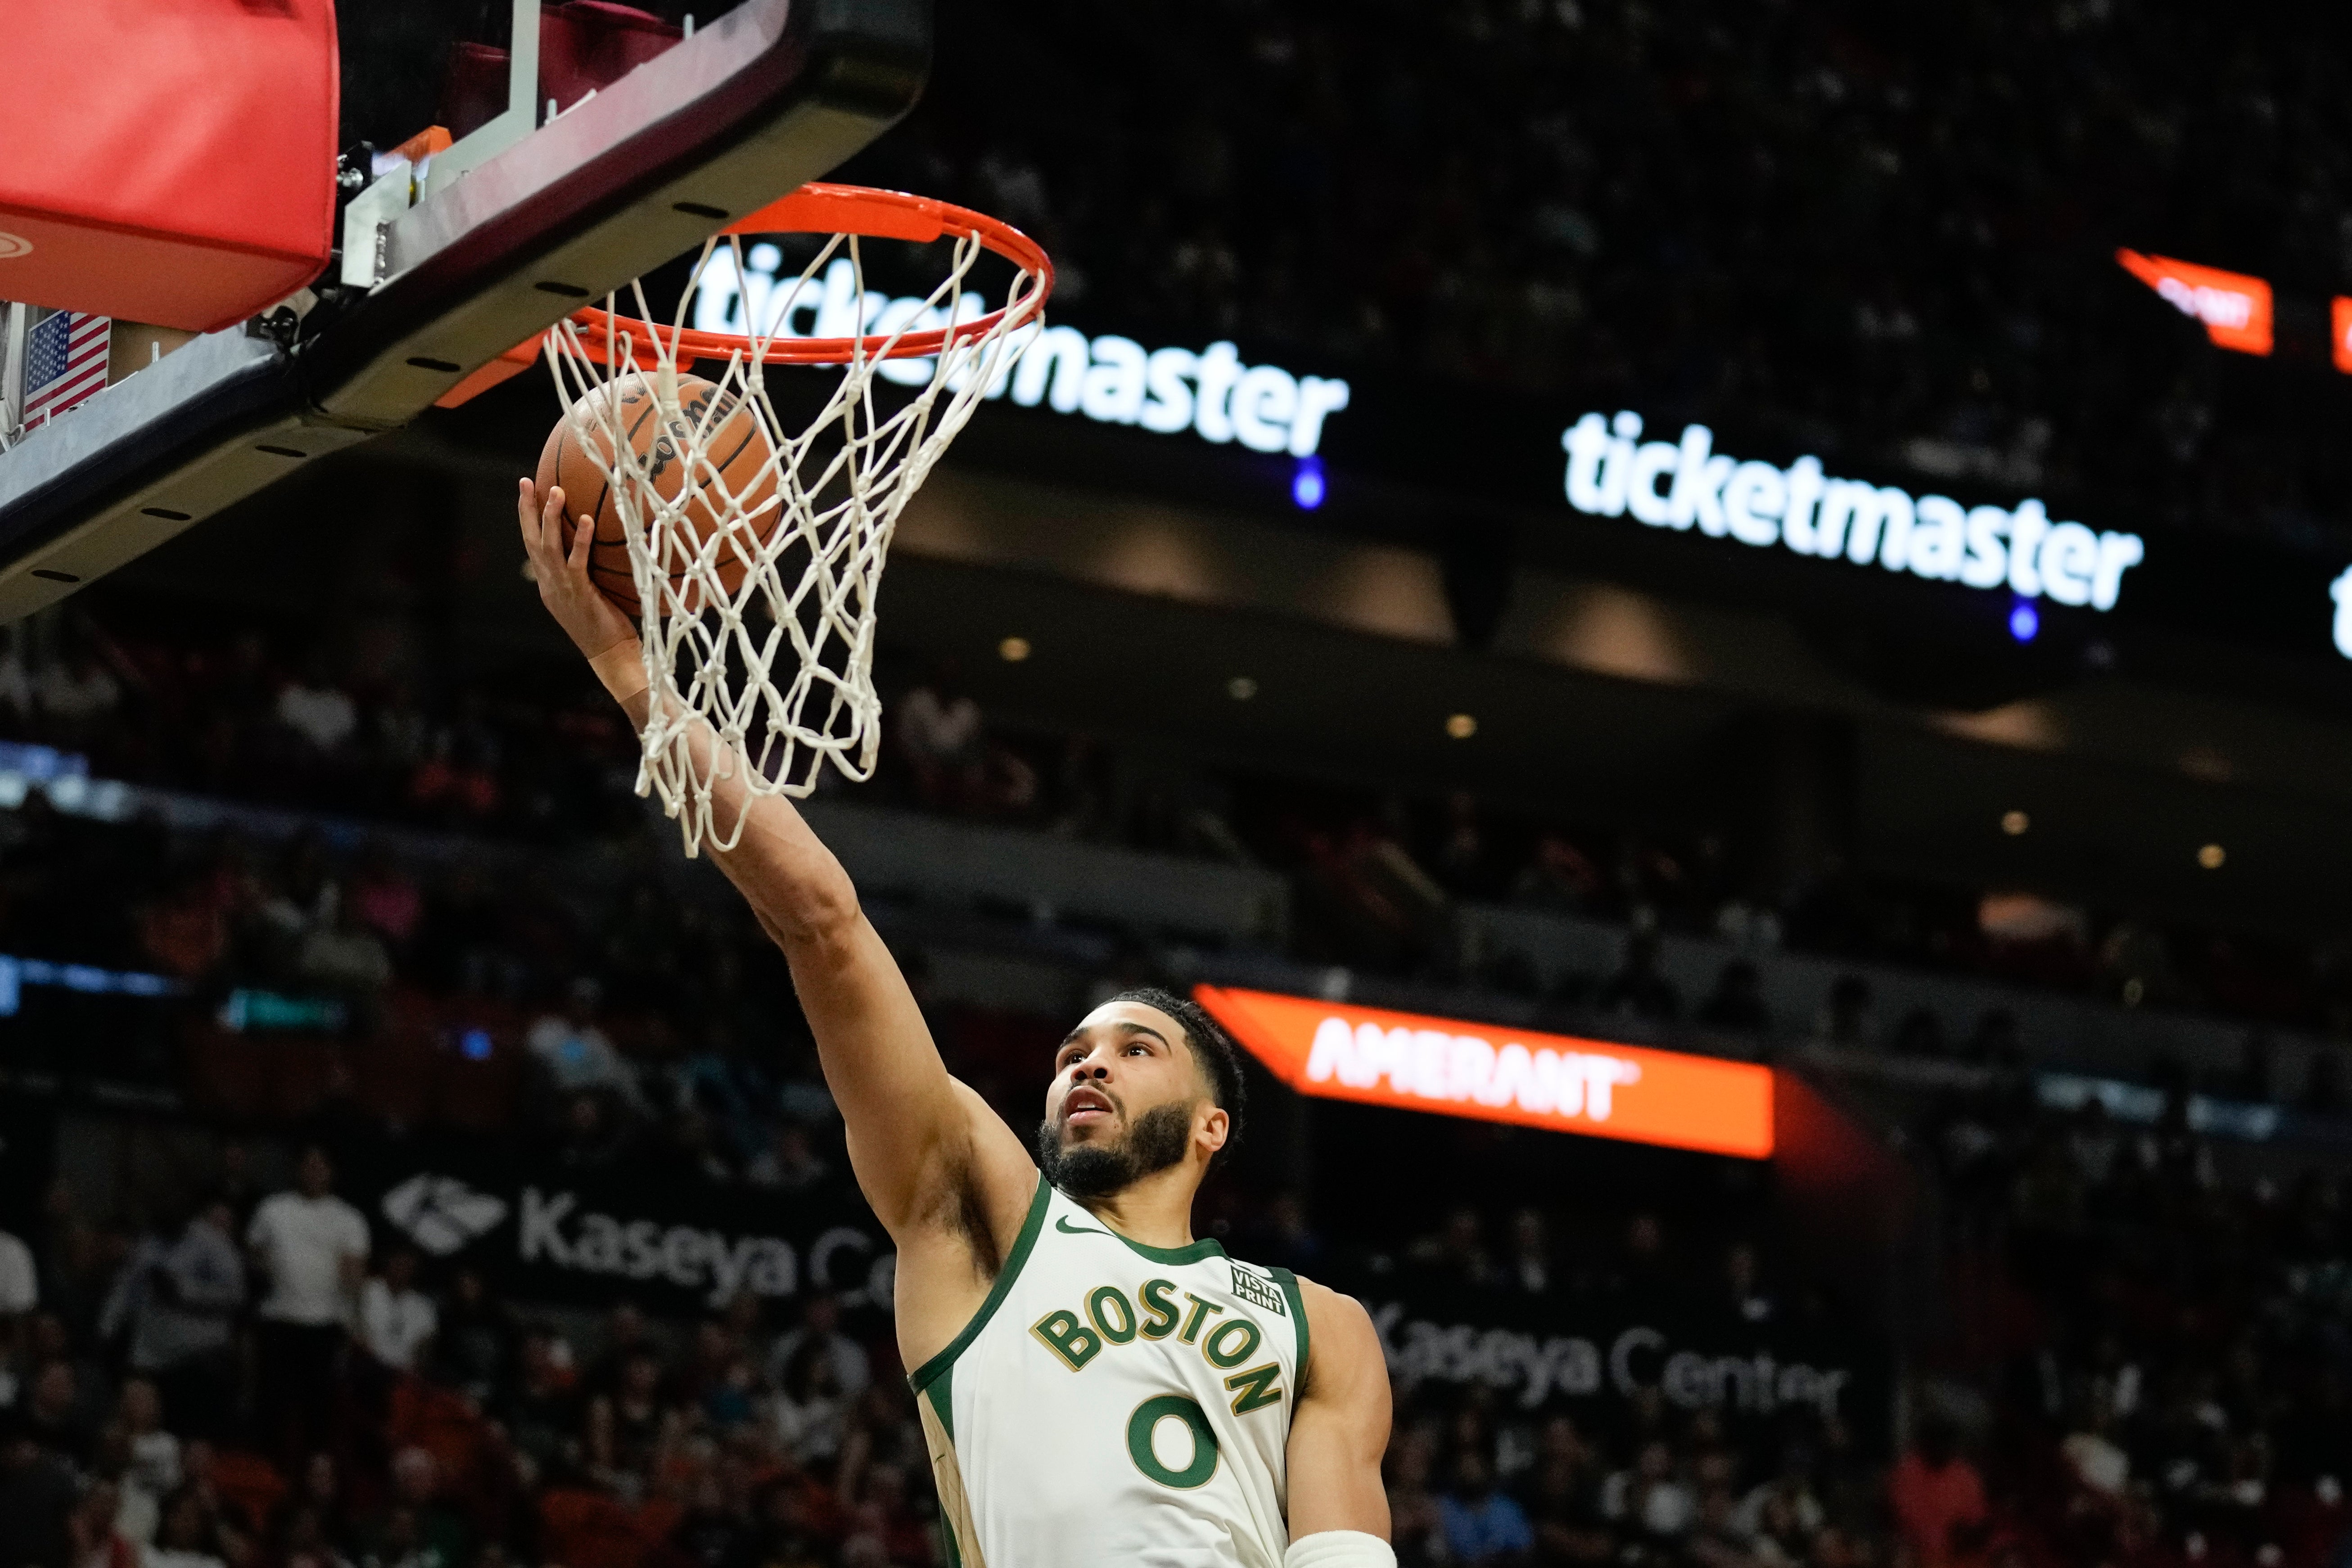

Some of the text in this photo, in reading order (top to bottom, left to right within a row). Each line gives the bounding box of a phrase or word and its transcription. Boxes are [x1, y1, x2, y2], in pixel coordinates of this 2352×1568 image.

[1562, 409, 2145, 612] ticketmaster
[1305, 1017, 1618, 1122] AMERANT
[519, 1185, 799, 1308] Kaseya
[1233, 1269, 1281, 1304] VISTA
[1235, 1283, 1282, 1314] PRINT
[1029, 1278, 1282, 1418] BOSTON
[1125, 1393, 1220, 1491] 0
